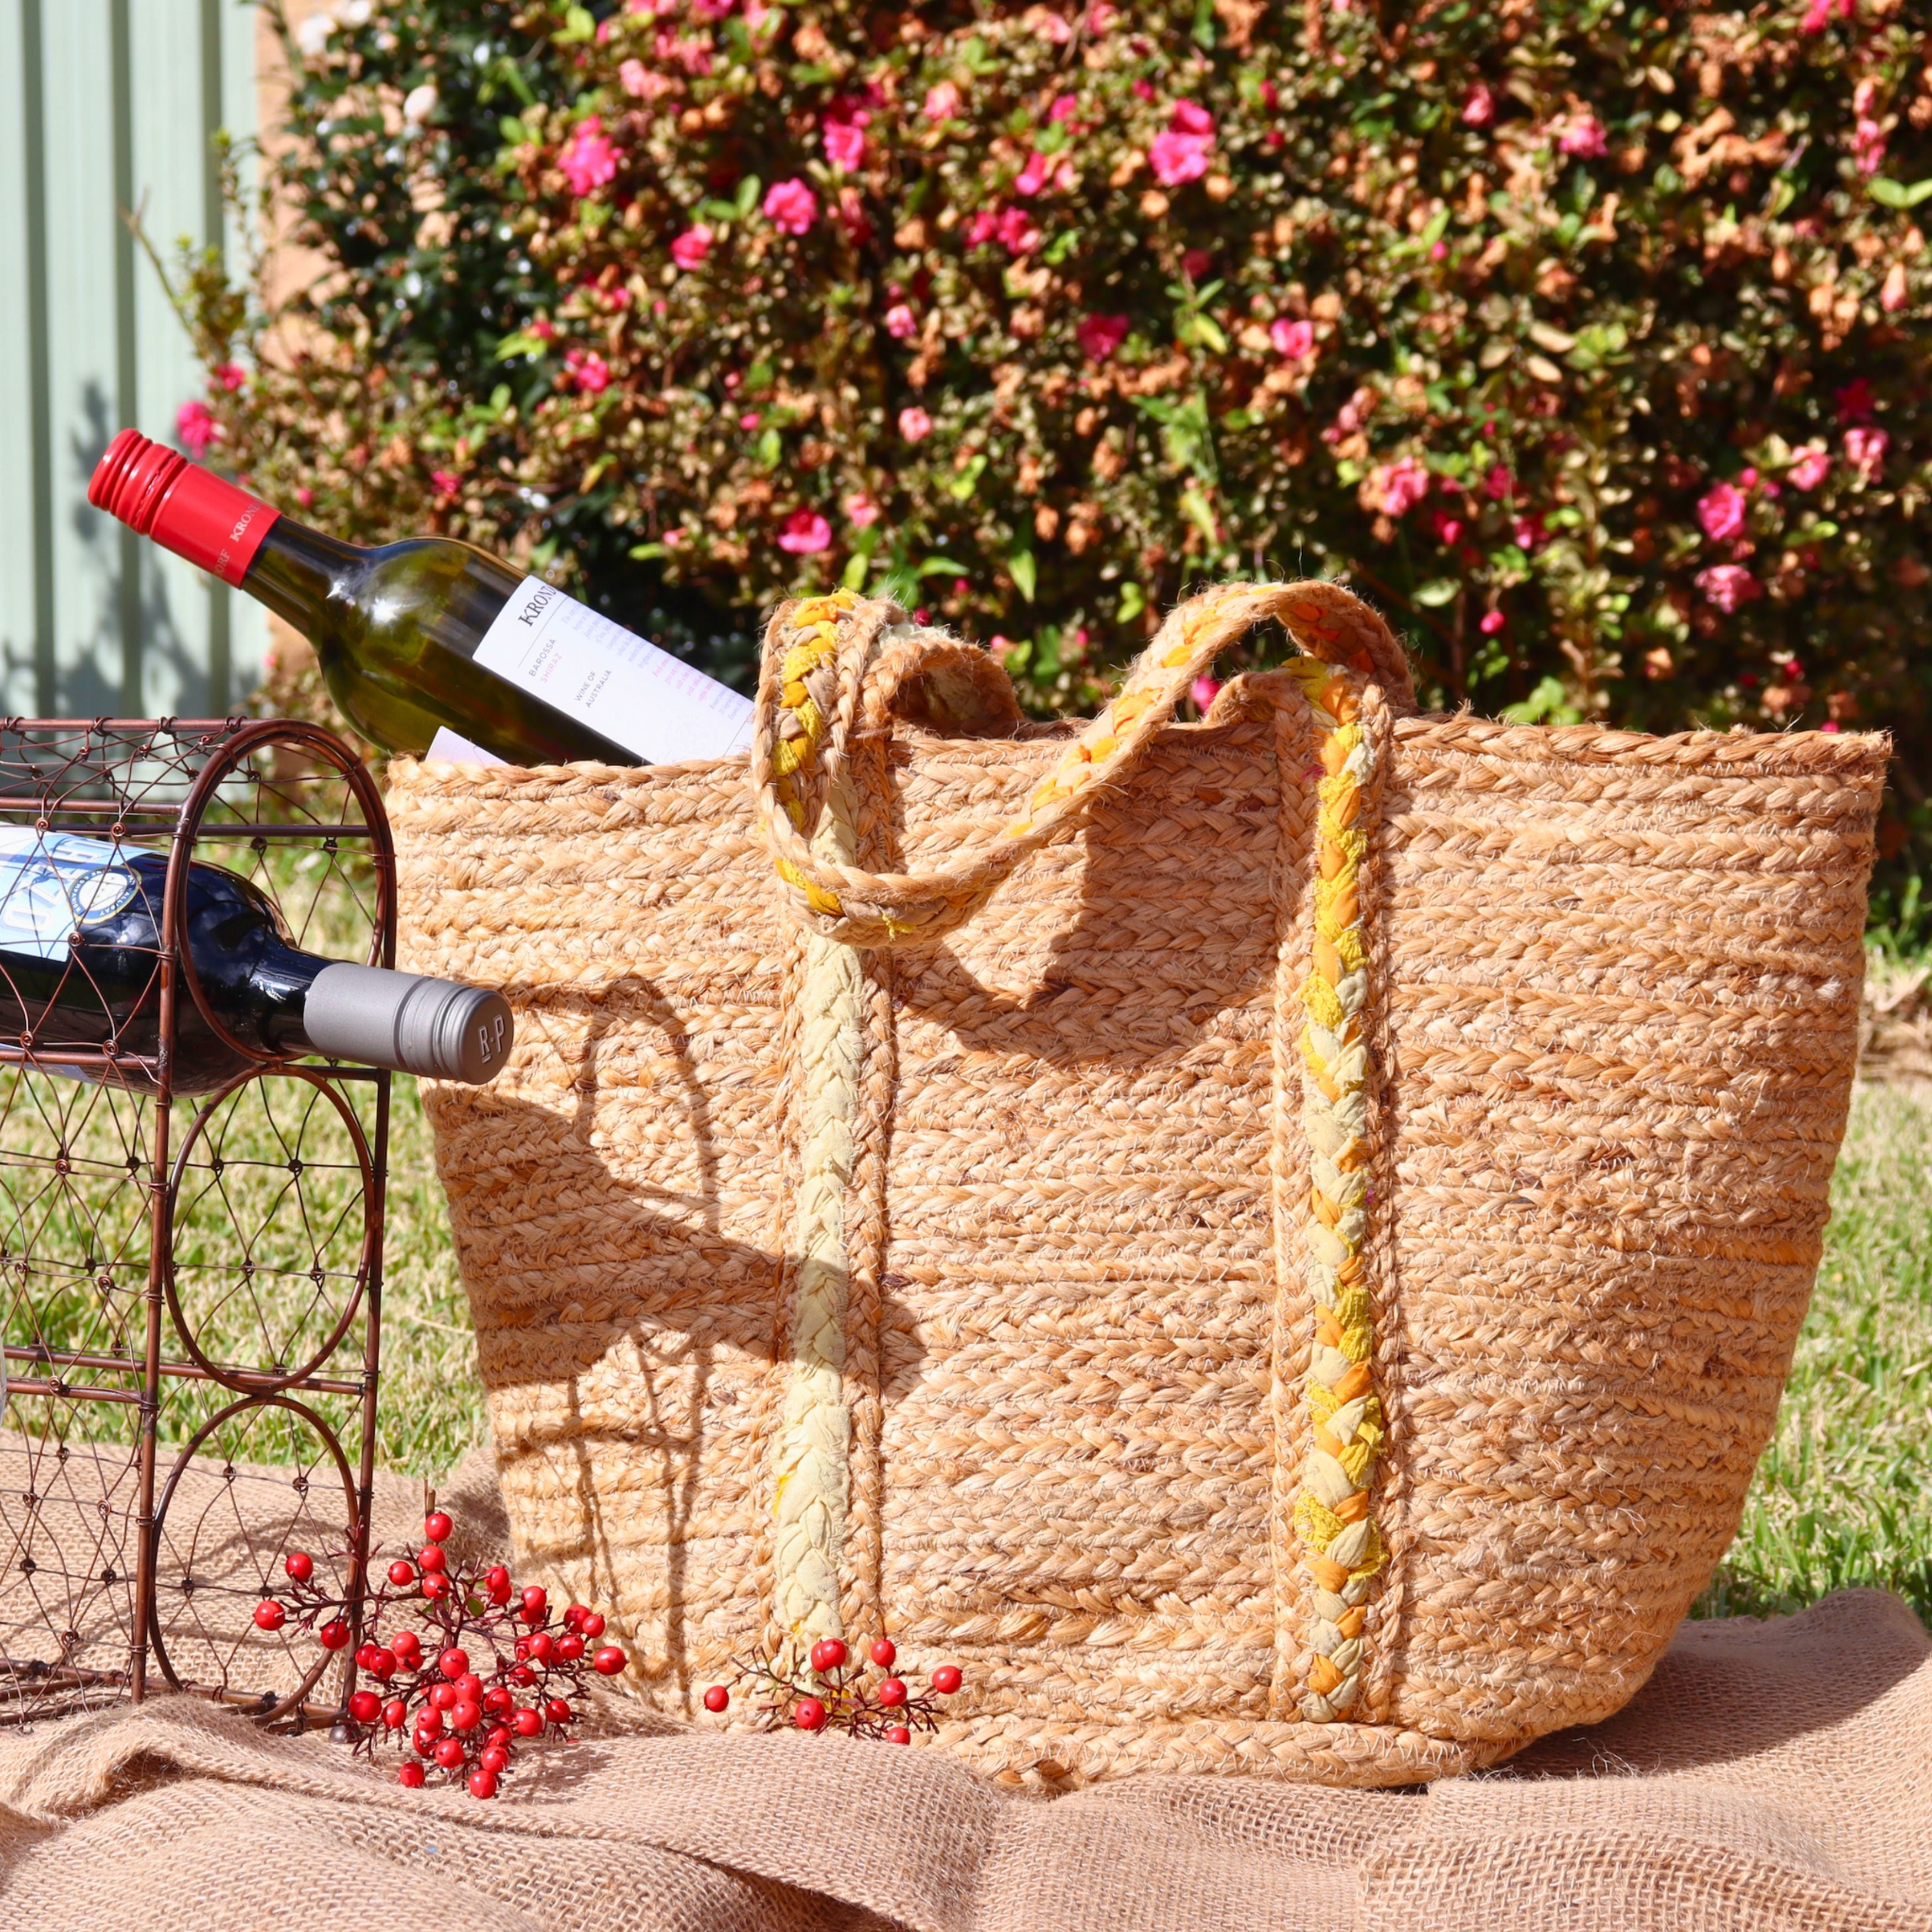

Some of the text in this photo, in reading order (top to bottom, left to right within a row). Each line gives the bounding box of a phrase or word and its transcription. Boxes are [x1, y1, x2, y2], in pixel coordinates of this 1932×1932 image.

[528, 638, 556, 677] BAROSSA
[540, 652, 562, 683] SHIRAZ
[574, 670, 596, 701] WINE OF
[585, 670, 612, 709] AUSTRALIA
